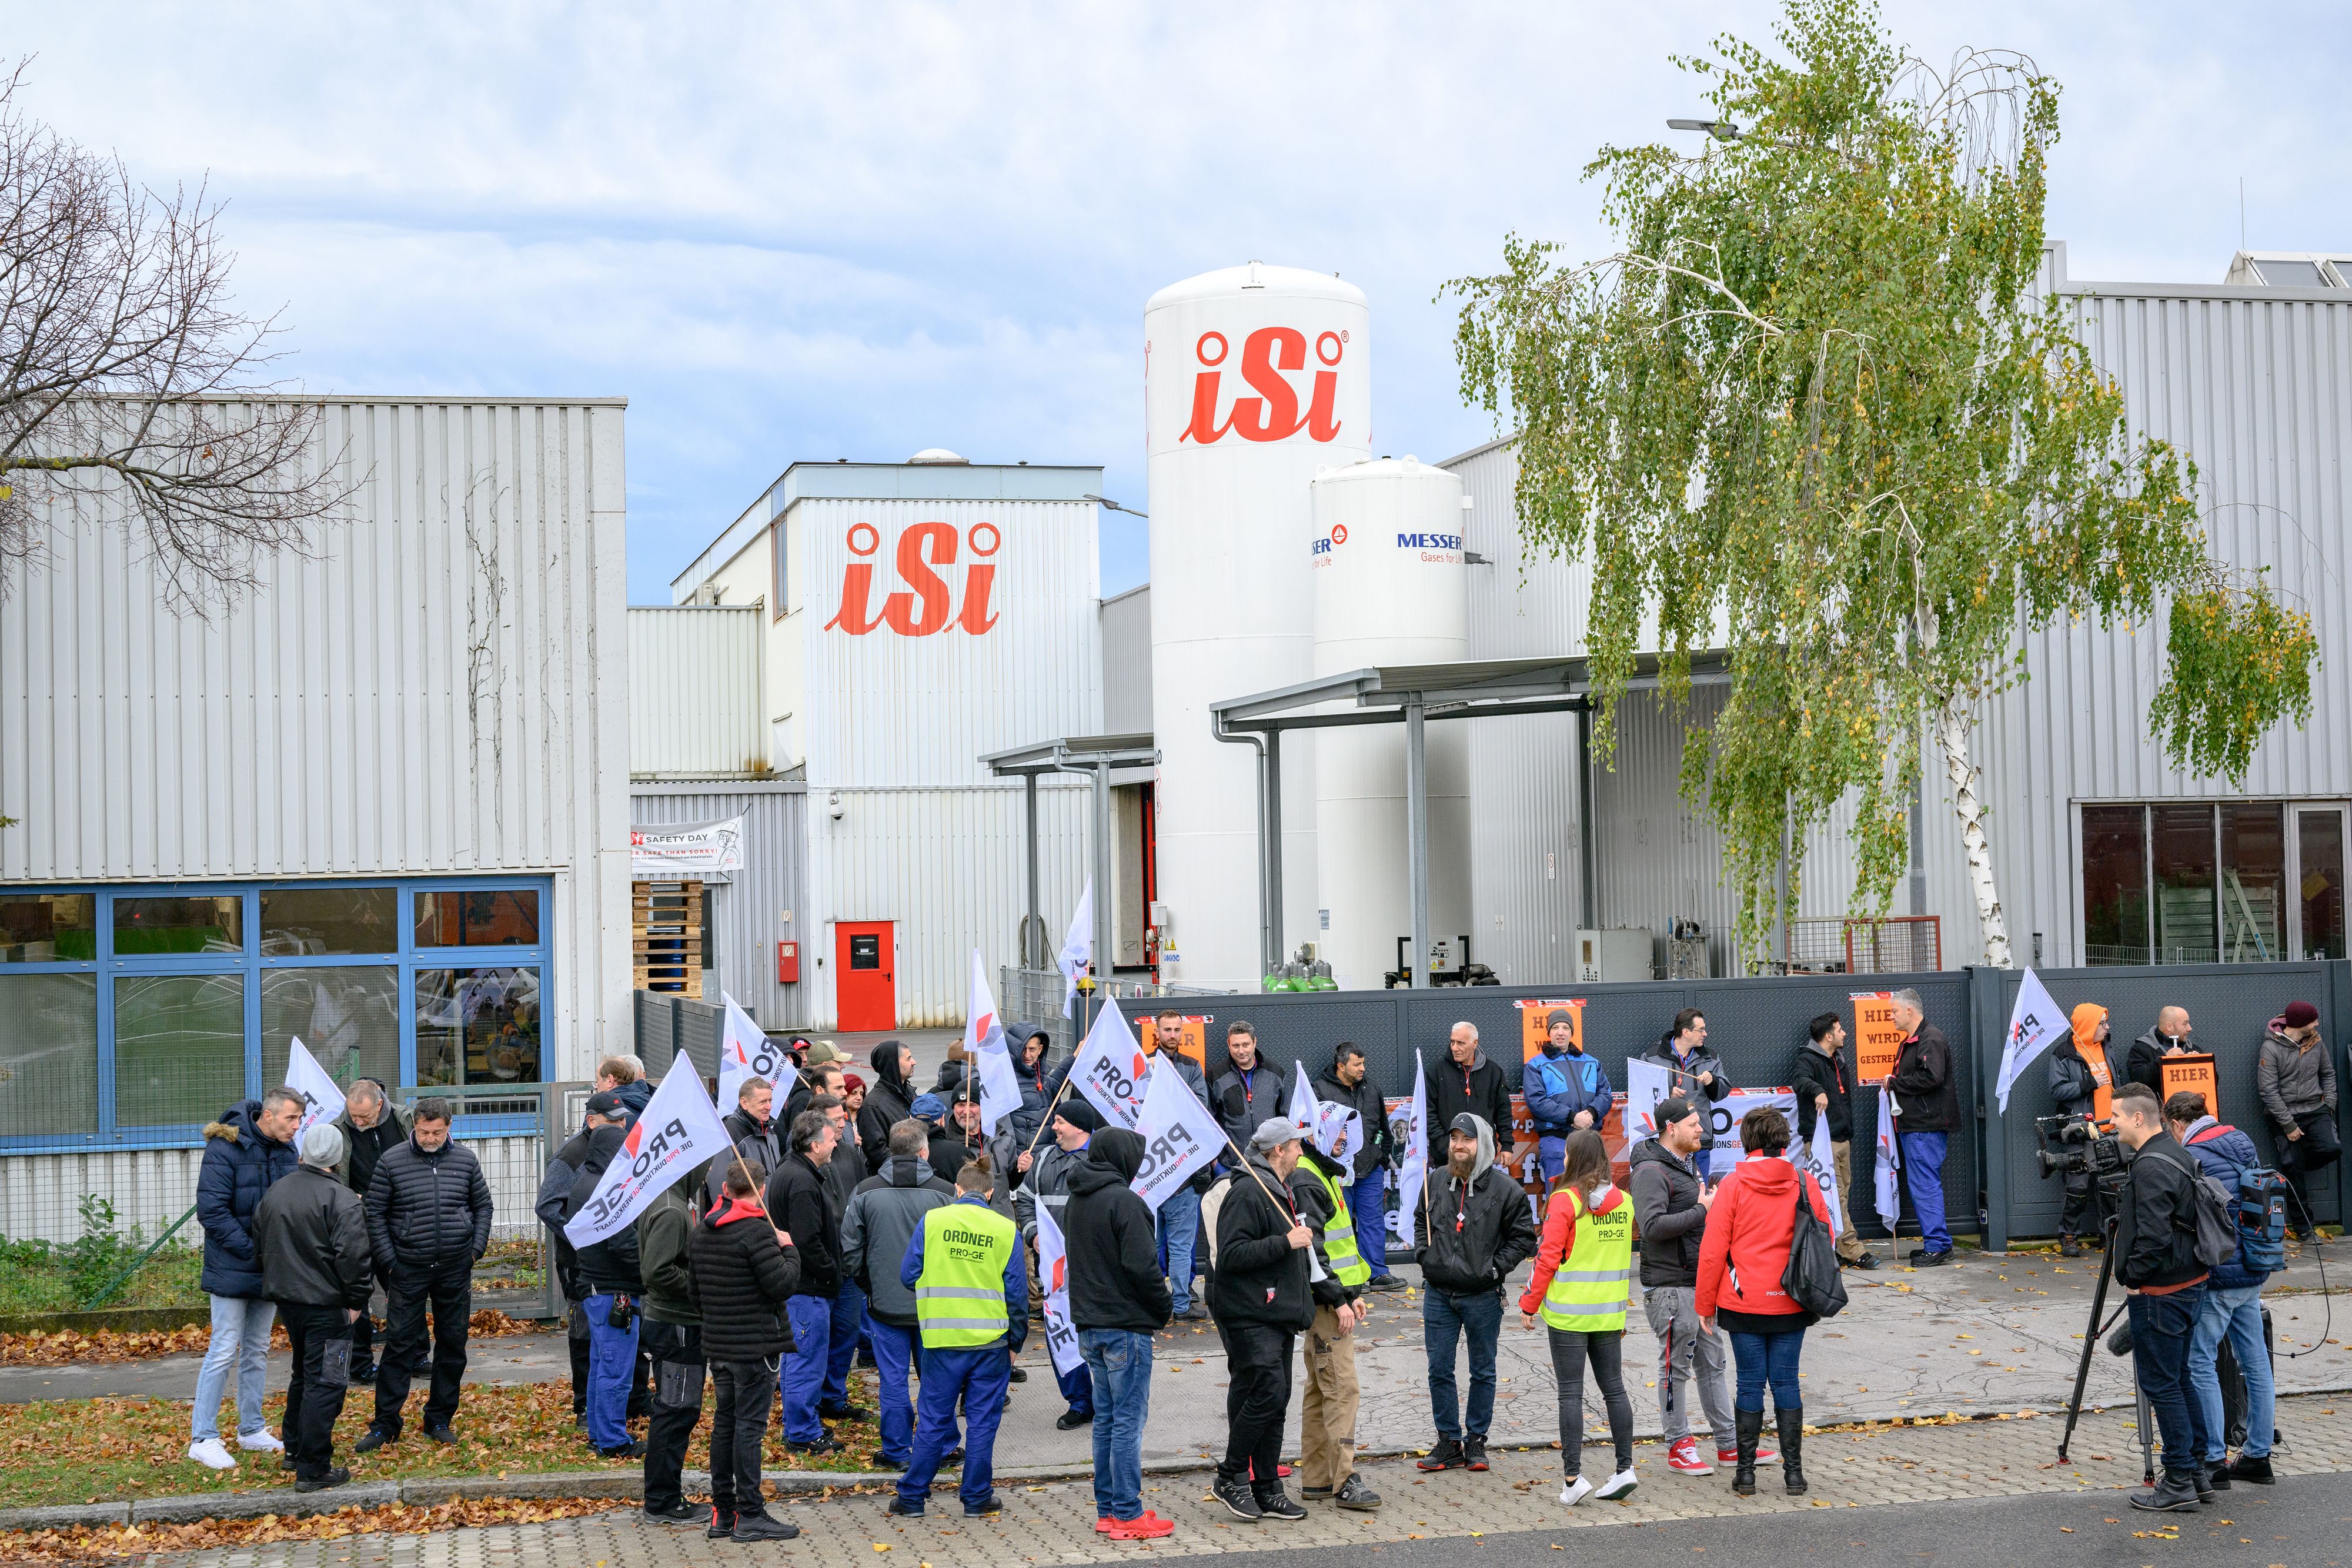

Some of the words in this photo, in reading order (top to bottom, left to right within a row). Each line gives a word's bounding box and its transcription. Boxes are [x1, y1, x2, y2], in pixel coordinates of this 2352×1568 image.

[1312, 538, 1331, 556] SER
[1397, 533, 1462, 550] MESSER
[1321, 556, 1332, 567] Life
[1421, 551, 1444, 563] Gases
[1446, 553, 1454, 563] for
[824, 522, 1001, 637] iSi
[631, 832, 645, 845] Si
[688, 834, 708, 842] DAY
[1864, 1009, 1892, 1022] HIE
[1866, 1032, 1900, 1044] WIRD
[1860, 1054, 1895, 1064] GESTRE
[2169, 1068, 2209, 1082] HIER
[1086, 1074, 1095, 1085] DIE
[1093, 1081, 1137, 1130] PRODUKTIONSGEWERKSC
[1592, 1211, 1628, 1226] ORDNER
[943, 1229, 994, 1248] ORDNER
